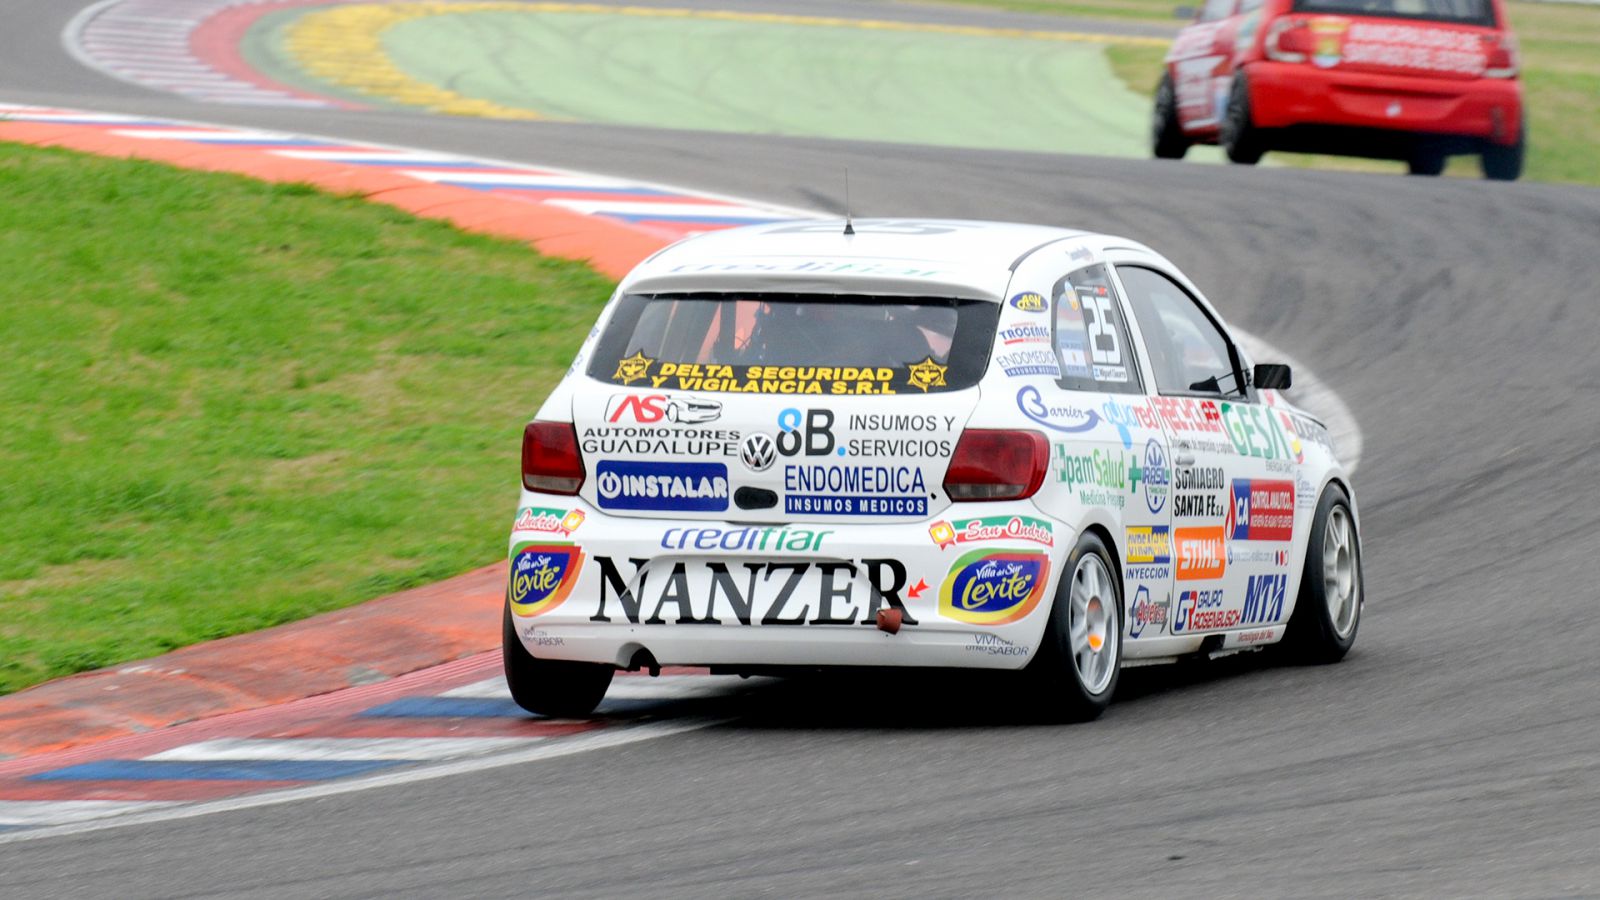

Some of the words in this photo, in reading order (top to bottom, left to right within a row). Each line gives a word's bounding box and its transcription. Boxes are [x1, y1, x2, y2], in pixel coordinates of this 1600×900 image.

[1081, 296, 1121, 364] 25
[659, 362, 734, 379] DELTA
[746, 365, 894, 382] SEGURIDAD
[651, 376, 668, 389] Y
[679, 376, 823, 393] VIGILANCIA
[1016, 385, 1086, 419] Barrier
[849, 413, 937, 433] INSUMOS
[938, 416, 956, 433] Y
[1221, 402, 1290, 460] GESA
[583, 427, 740, 441] AUTOMOTORES
[582, 439, 739, 457] GUADALUPE
[848, 439, 952, 459] SERVICIOS
[622, 475, 728, 498] INSTALAR
[784, 465, 926, 493] ENDOMEDICA
[1175, 468, 1225, 490] SUMIAGRO
[789, 498, 852, 513] INSUMOS
[860, 499, 925, 513] MEDICOS
[1174, 495, 1204, 517] SANTA
[1205, 496, 1216, 516] FE
[1237, 497, 1249, 526] CA
[966, 522, 1001, 540] San
[1181, 538, 1220, 571] STIHL
[975, 561, 996, 579] Villa
[1005, 563, 1022, 576] Sur
[1126, 568, 1169, 579] INYECCION
[590, 556, 918, 625] NANZER
[1197, 589, 1224, 609] GRUPO
[1240, 574, 1287, 624] MTH
[1193, 609, 1241, 631] ROSENBUSCH
[975, 634, 996, 644] VIVI
[988, 646, 1029, 656] SABOR
